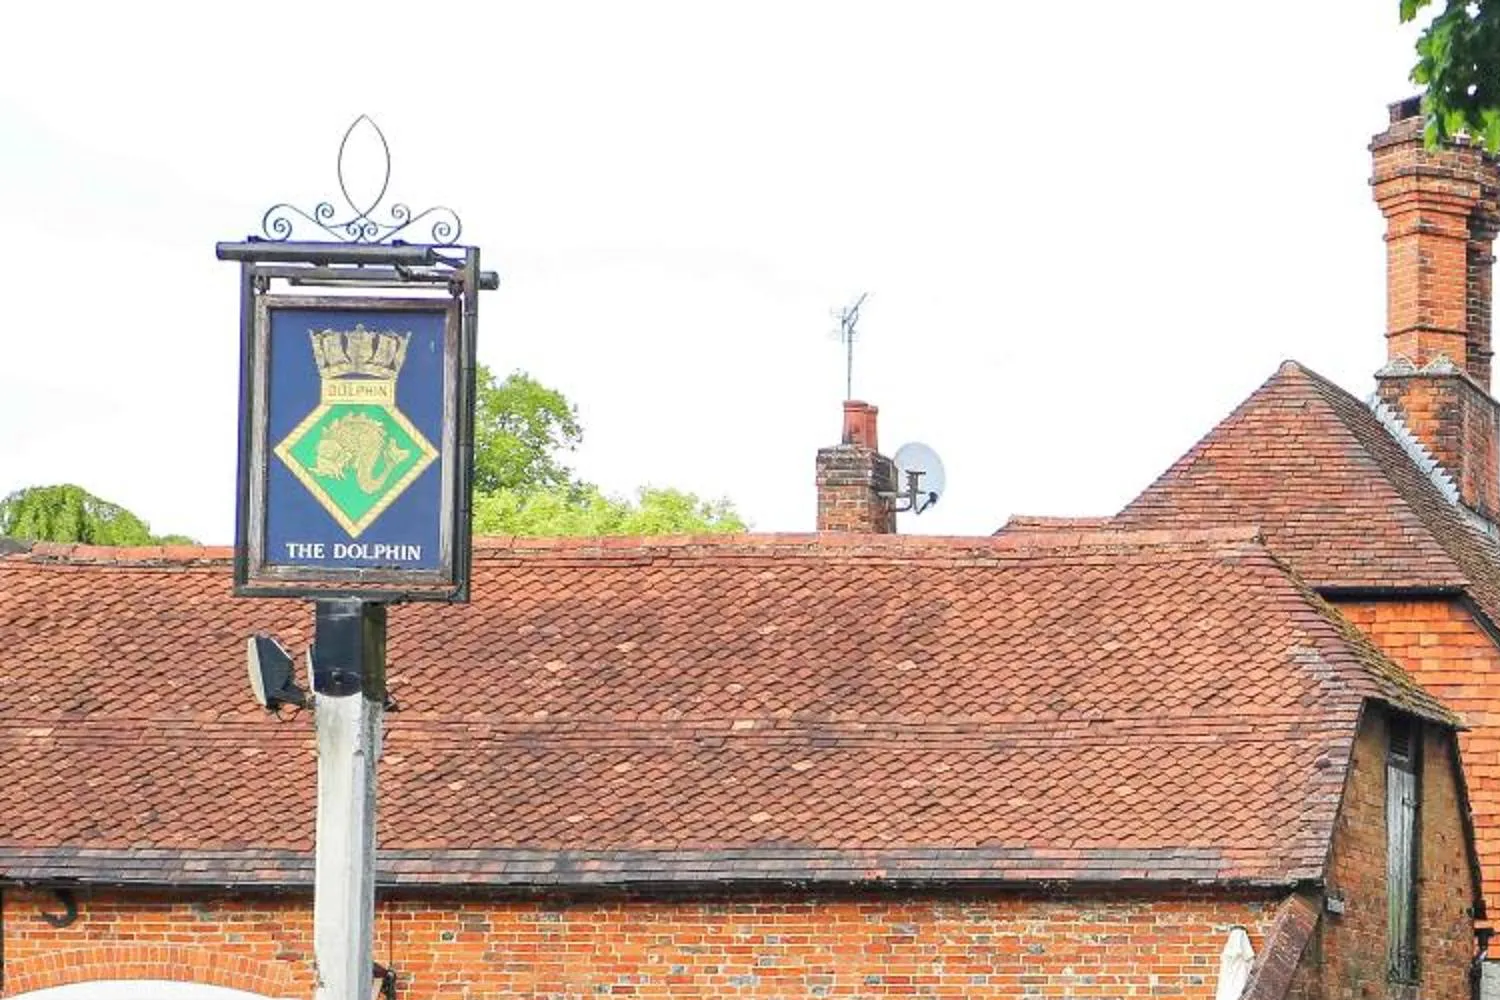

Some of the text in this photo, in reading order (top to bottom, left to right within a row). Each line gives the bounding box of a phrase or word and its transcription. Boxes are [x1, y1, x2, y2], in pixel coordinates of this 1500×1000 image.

[328, 382, 388, 397] DOLPHIN
[285, 543, 421, 561] THE DOLPHIN
